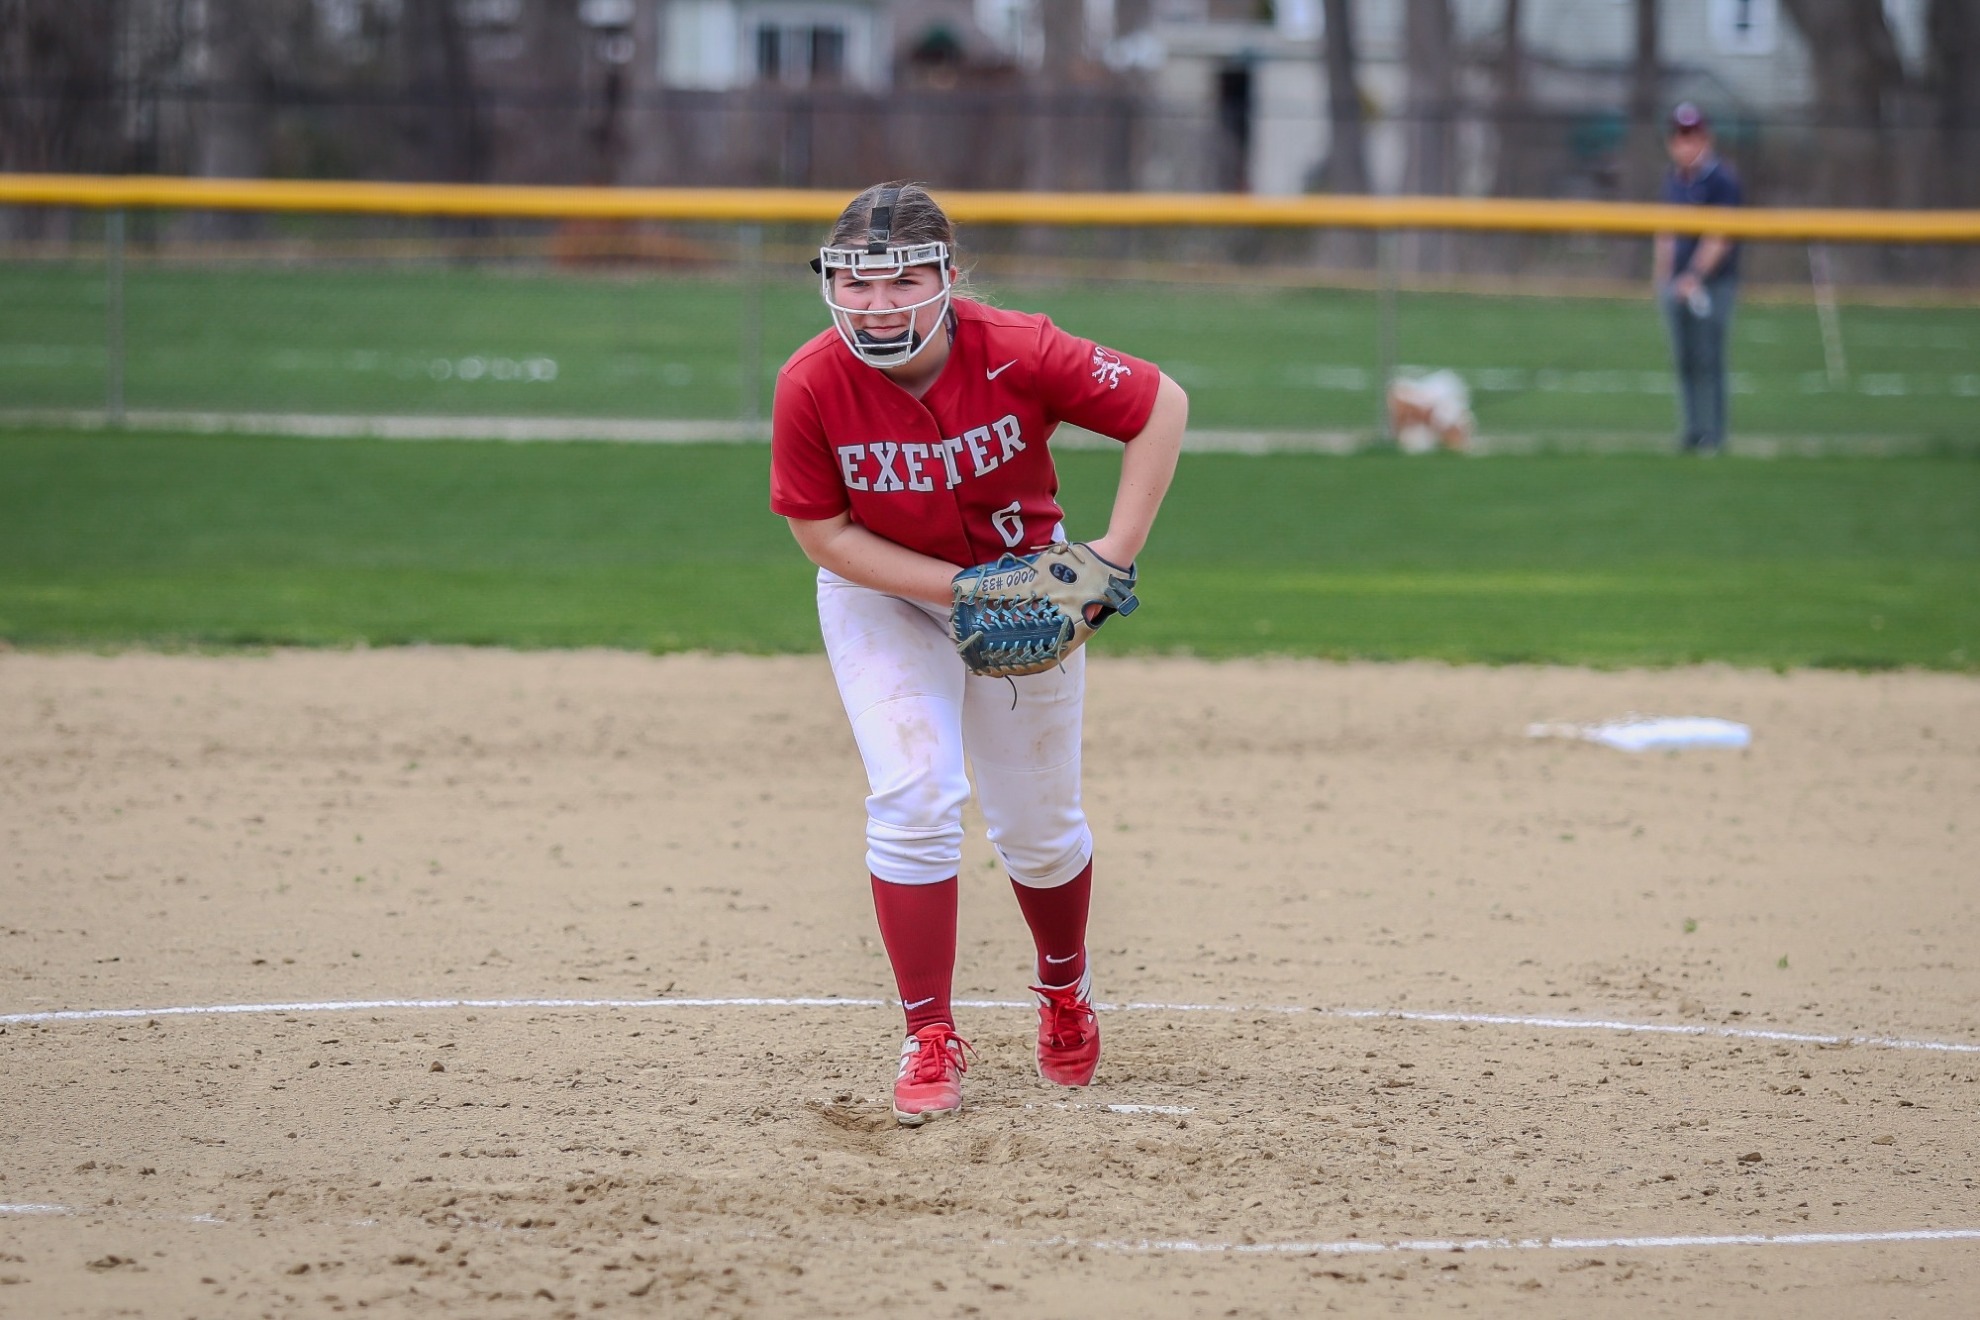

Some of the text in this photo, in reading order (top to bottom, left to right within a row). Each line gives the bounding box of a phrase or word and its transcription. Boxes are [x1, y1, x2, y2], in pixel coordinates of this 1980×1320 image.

[838, 414, 1027, 492] EXETER
[991, 500, 1025, 548] 6
[982, 576, 1004, 592] #33
